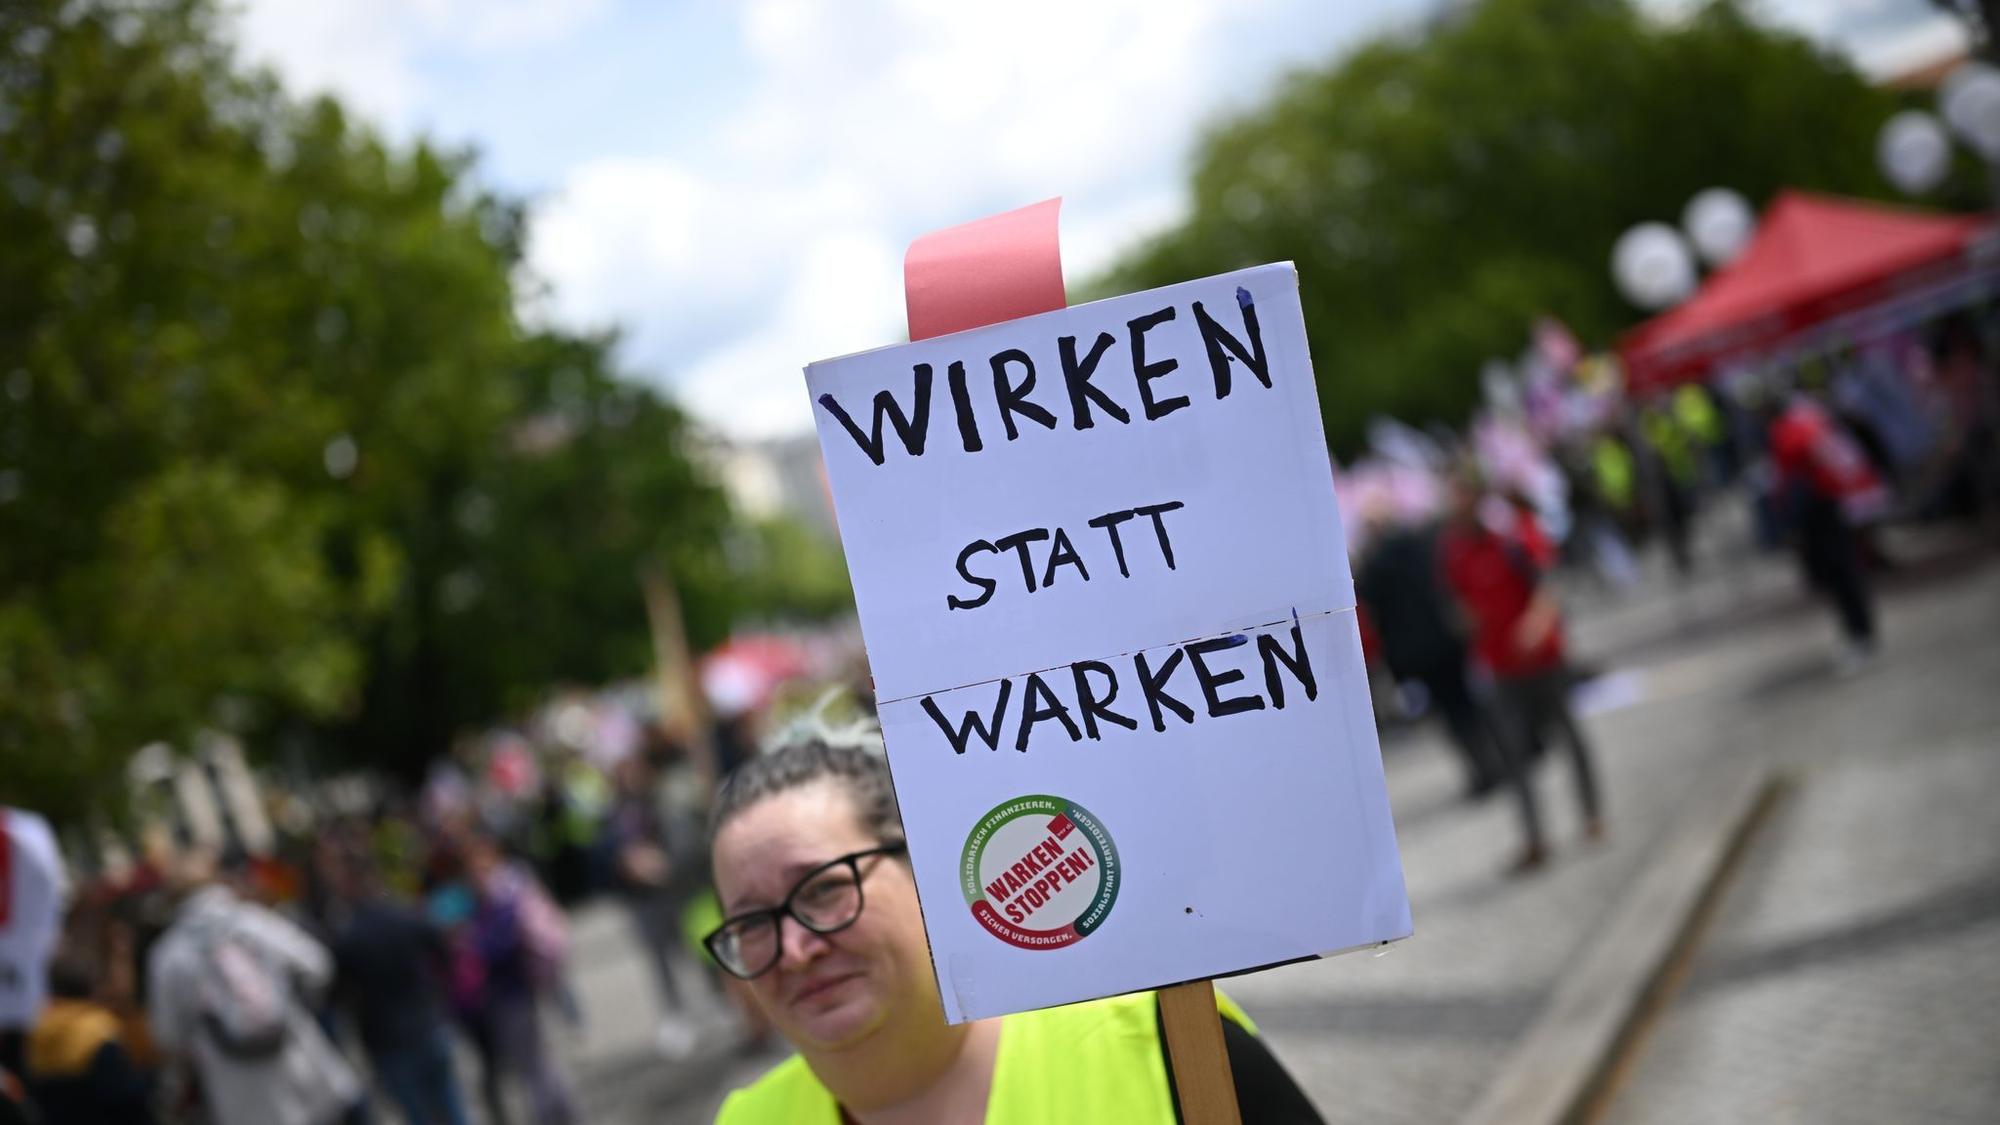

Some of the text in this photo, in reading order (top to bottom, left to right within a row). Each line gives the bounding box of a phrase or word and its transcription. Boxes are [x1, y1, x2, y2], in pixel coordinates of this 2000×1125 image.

[818, 286, 1273, 466] WIRKEN
[946, 500, 1185, 611] STATT
[920, 608, 1318, 755] WARKEN
[966, 800, 1056, 894] SOLIDARISCH FINANZIEREN.
[985, 835, 1065, 904] WARKEN
[1005, 847, 1095, 924] STOPPEN!
[1072, 809, 1115, 928] SOZIALSTAAT VERTEIDIGEN.
[979, 909, 1073, 945] SICHER VERSORGEN.
